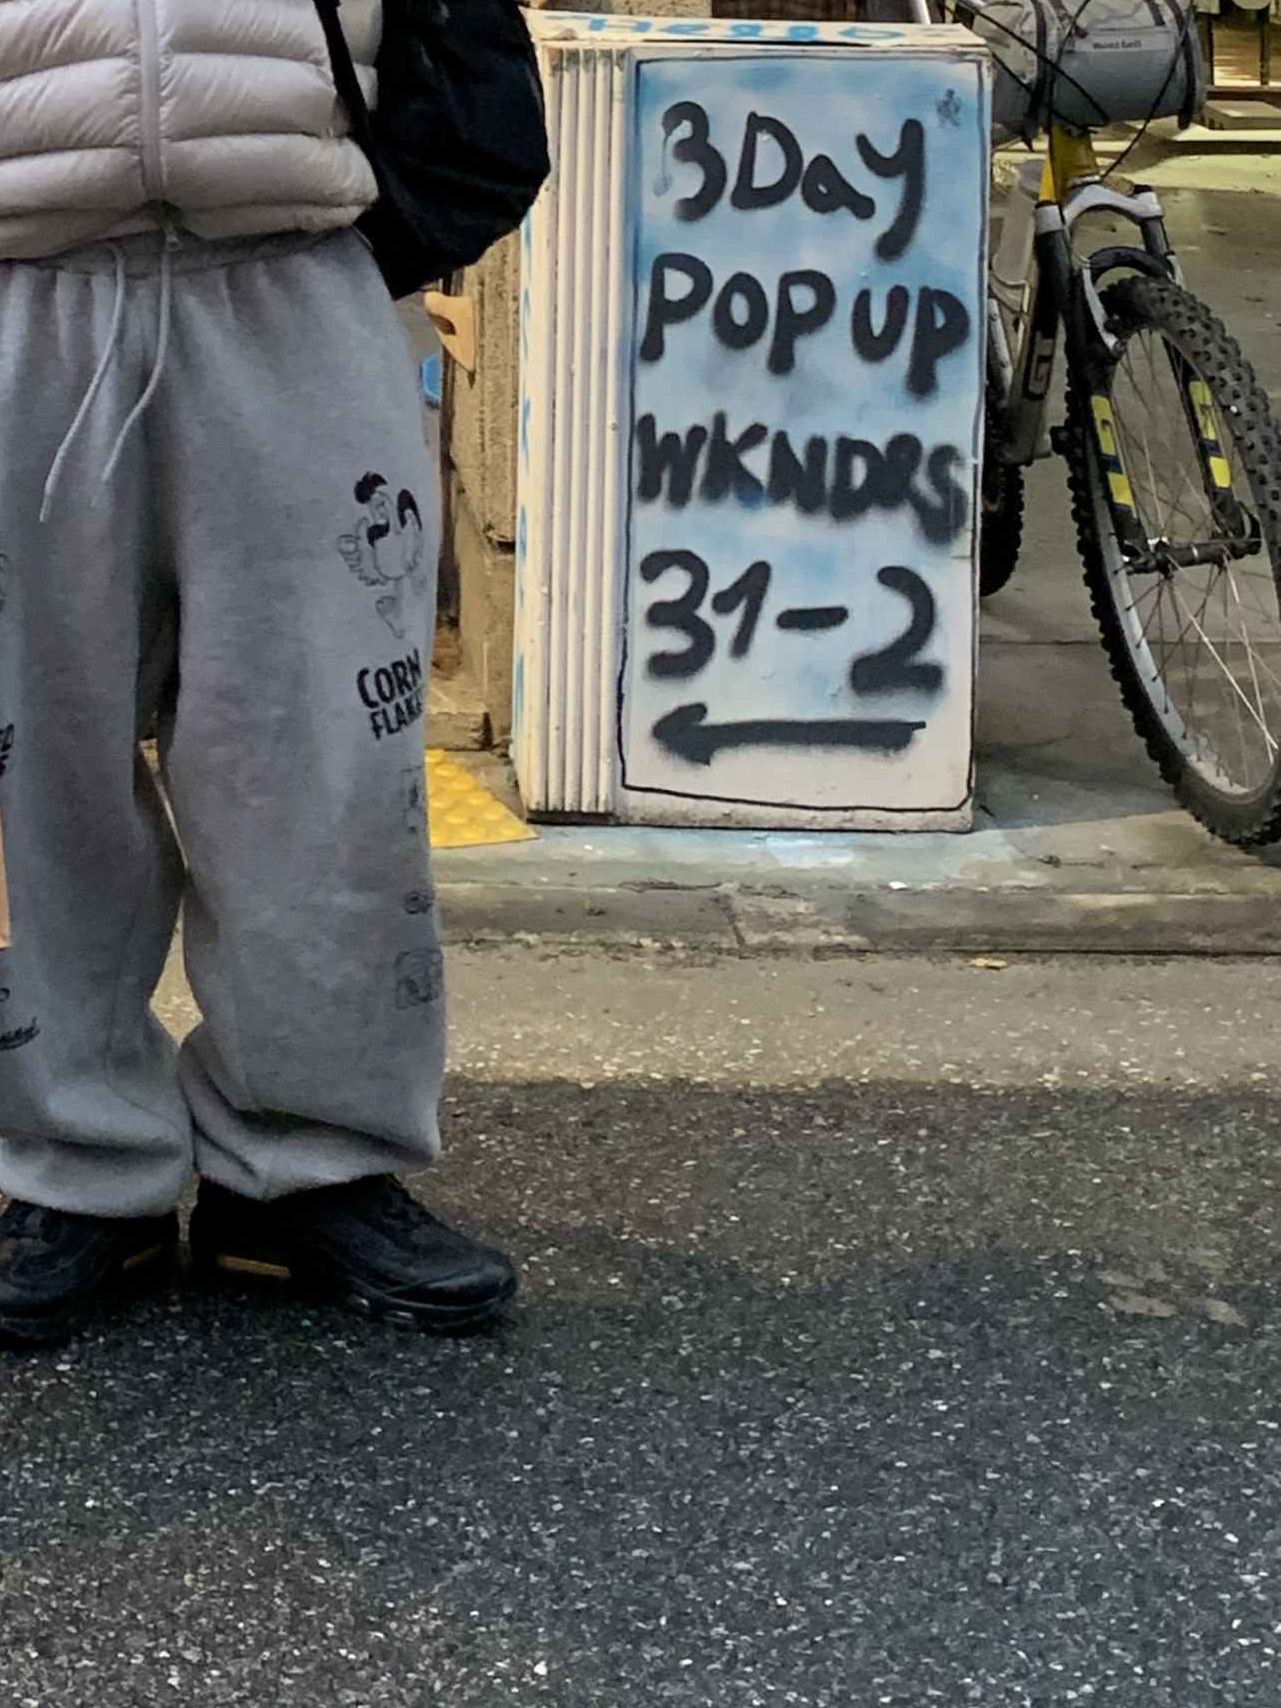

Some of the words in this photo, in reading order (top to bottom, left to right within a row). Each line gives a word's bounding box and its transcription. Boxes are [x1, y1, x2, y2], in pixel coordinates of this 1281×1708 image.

[639, 252, 836, 376] POP
[850, 285, 969, 397] UP
[636, 411, 969, 544] WKNDRS
[357, 647, 422, 708] CORN
